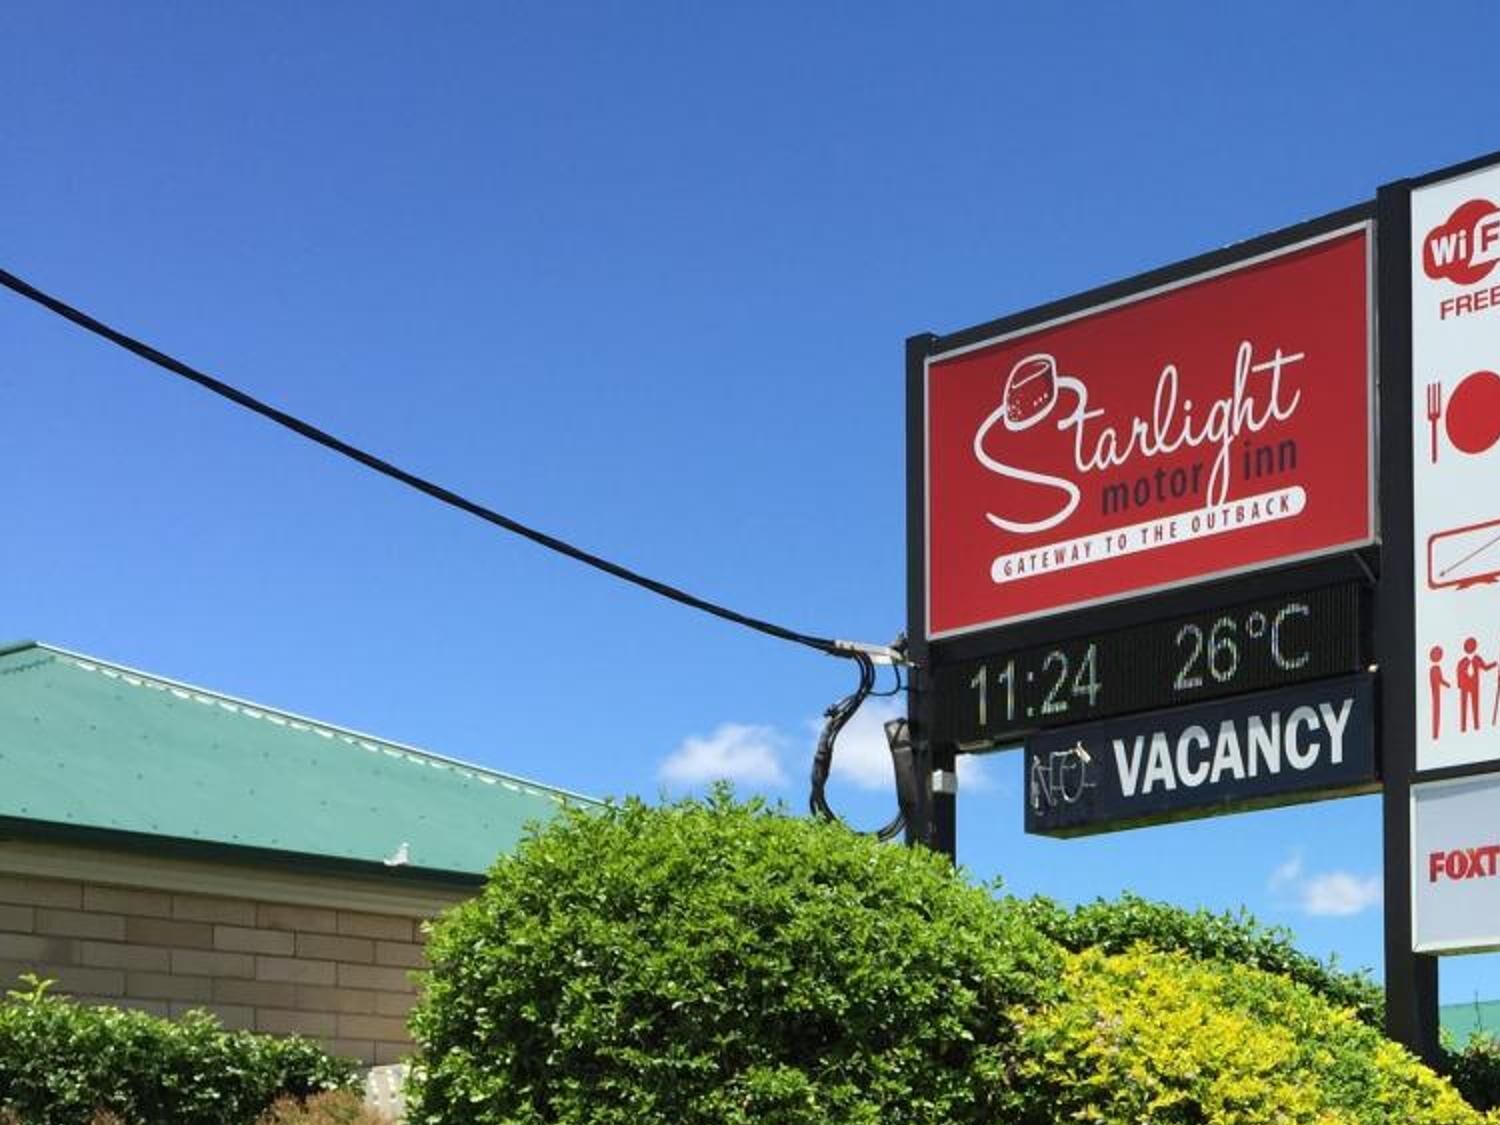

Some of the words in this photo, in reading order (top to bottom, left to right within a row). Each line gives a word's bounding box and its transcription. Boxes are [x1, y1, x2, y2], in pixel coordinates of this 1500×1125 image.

[973, 340, 1305, 534] Starlight
[1102, 462, 1203, 516] motor
[1242, 438, 1298, 481] inn
[1003, 542, 1092, 577] GATEWAY
[1106, 533, 1128, 552] TO
[1142, 520, 1178, 543] THE
[1191, 494, 1291, 534] OUTBACK
[970, 641, 1102, 725] 11:24
[1113, 698, 1355, 798] VACANCY
